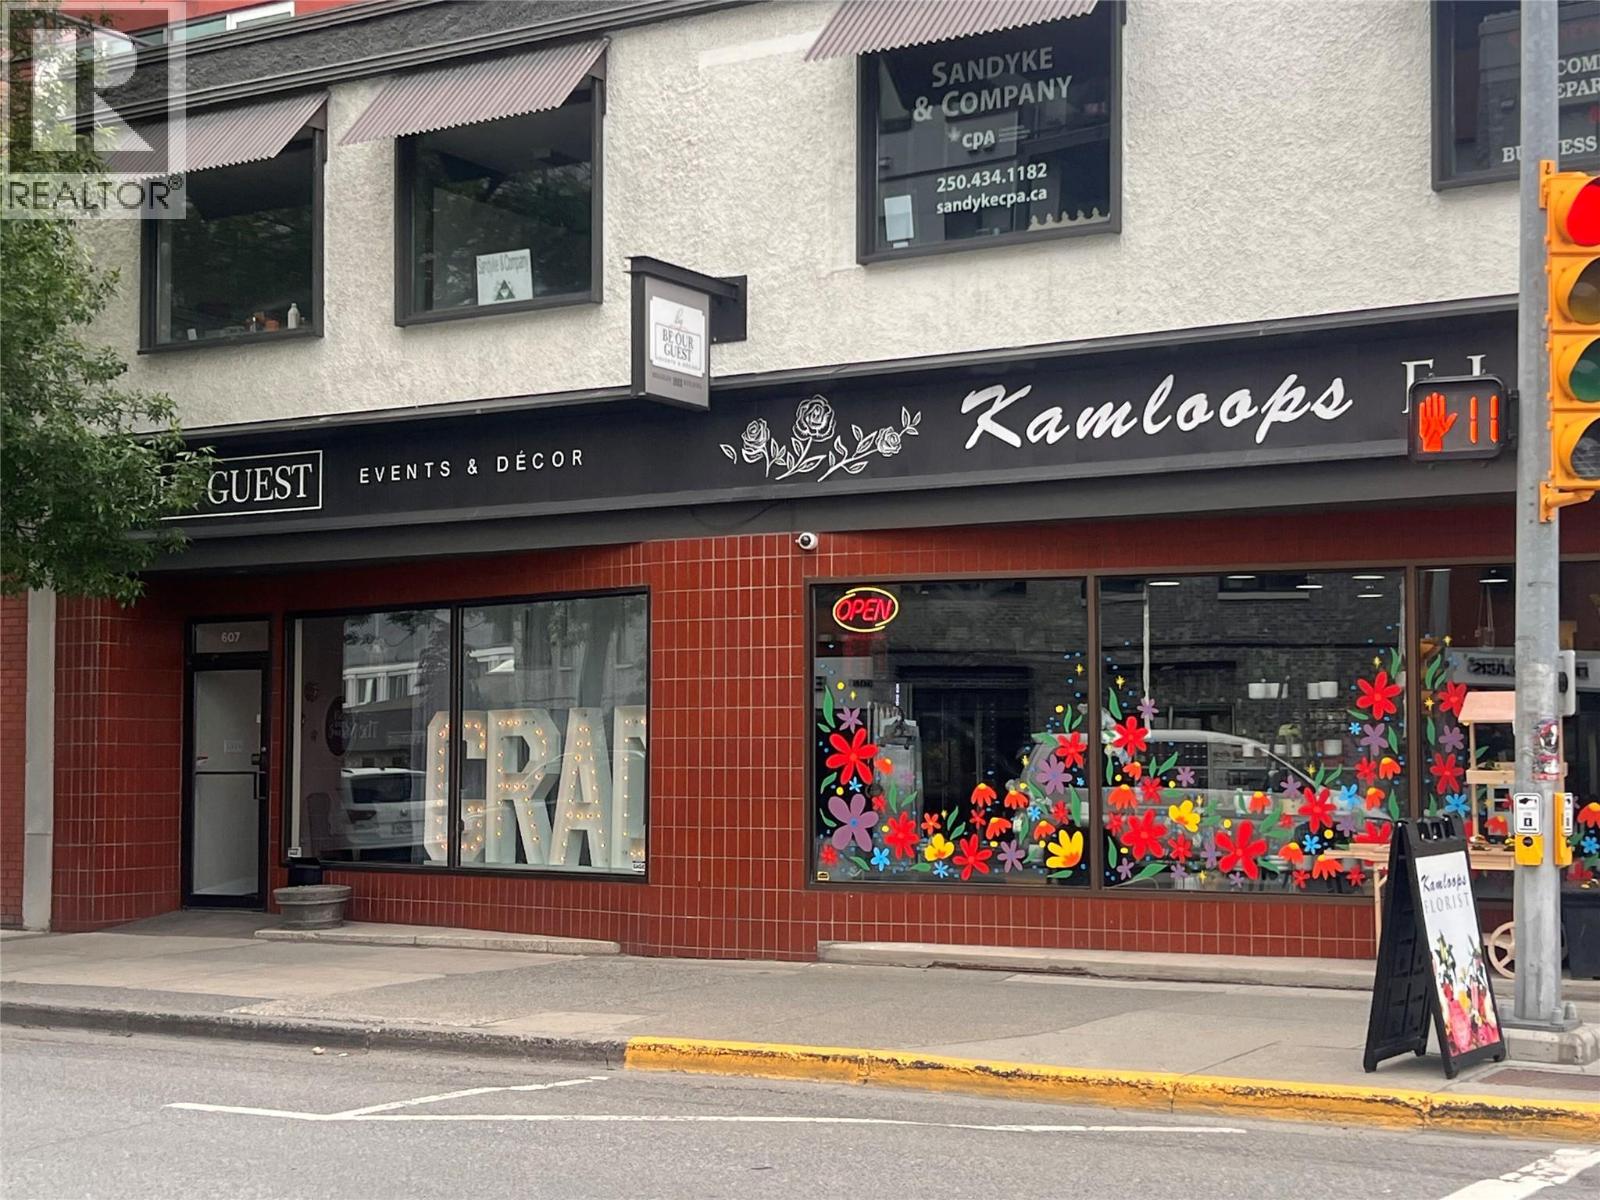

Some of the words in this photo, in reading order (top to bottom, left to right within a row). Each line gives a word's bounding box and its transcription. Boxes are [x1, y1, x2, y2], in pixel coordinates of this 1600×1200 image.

[932, 47, 1053, 88] SANDYKE
[913, 96, 933, 122] &
[941, 75, 1073, 117] COMPANY
[936, 162, 1048, 192] 250.434.1182
[936, 188, 1048, 214] sandykecpa.ca
[663, 328, 674, 344] BE
[675, 332, 694, 350] OUR
[664, 343, 692, 362] GUEST
[960, 373, 1354, 449] Kamloops
[1469, 394, 1500, 445] 11
[359, 460, 451, 484] EVENTS
[467, 457, 479, 475] &
[496, 449, 584, 473] DÉCOR
[207, 463, 313, 505] GUEST
[836, 598, 893, 622] OPEN
[221, 631, 241, 643] 607
[1420, 872, 1467, 893] Kamloops
[1424, 892, 1470, 914] FLORIST
